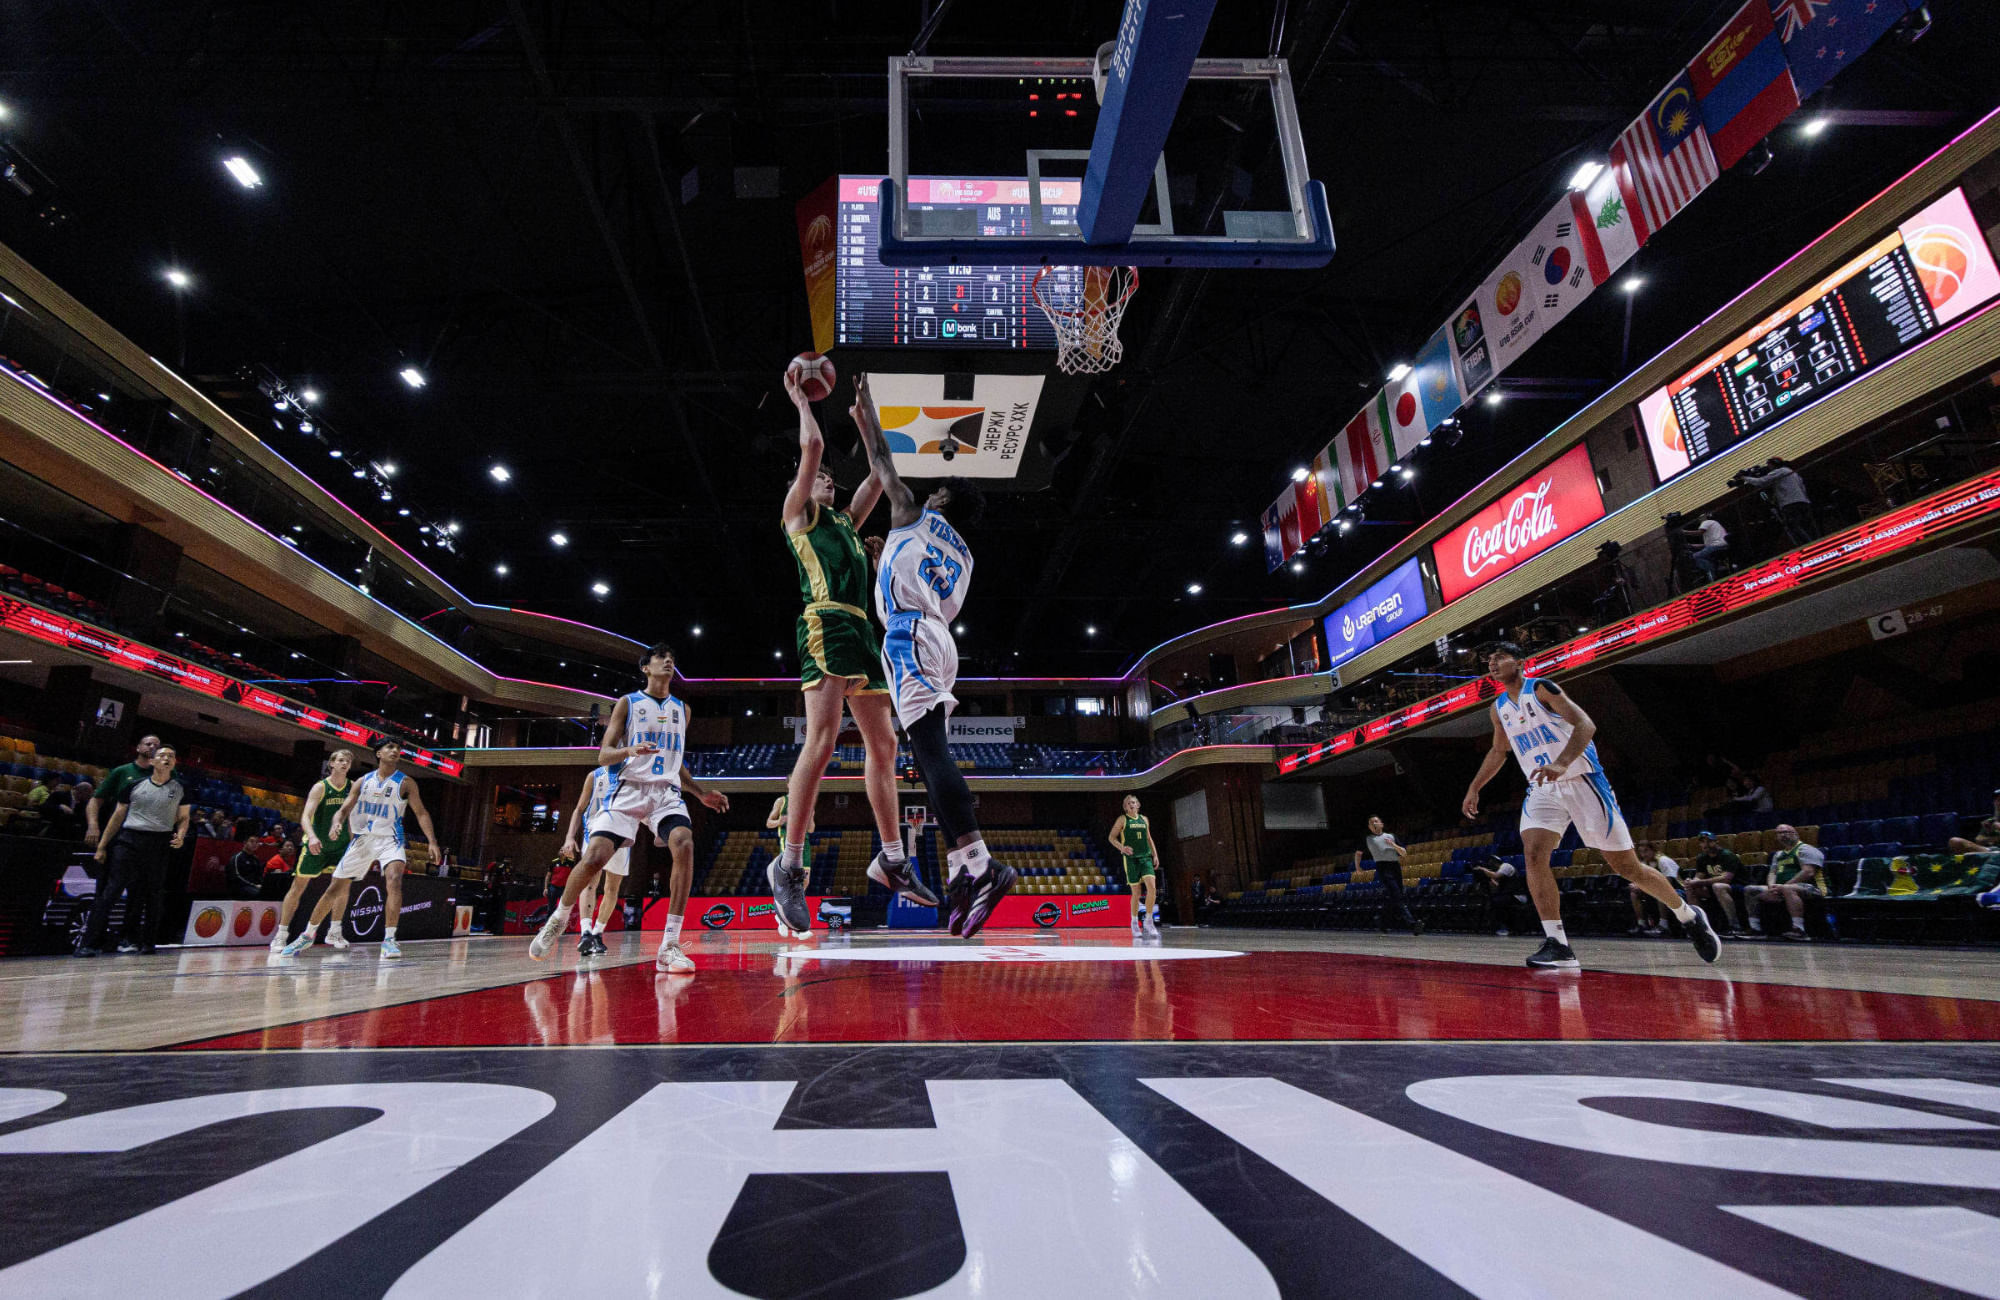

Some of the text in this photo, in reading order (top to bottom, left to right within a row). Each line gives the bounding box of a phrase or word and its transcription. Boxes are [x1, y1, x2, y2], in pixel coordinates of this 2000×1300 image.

[987, 207, 1001, 221] AUS
[923, 286, 929, 300] 2
[956, 285, 965, 299] 21
[992, 287, 998, 301] 2
[1524, 310, 1535, 325] CUP
[923, 321, 929, 336] 3
[993, 321, 997, 337] 1
[1812, 331, 1821, 343] 7
[1464, 347, 1485, 371] FIBA
[983, 411, 1006, 452] ЭНЕРЖИ
[1000, 402, 1030, 460] РЕСУРС ХХК
[1462, 476, 1558, 578] Coca-Cola
[918, 541, 962, 601] 23
[1386, 608, 1404, 623] GROUP
[1878, 615, 1897, 634] C
[104, 702, 116, 718] A
[950, 724, 1013, 736] Hisense
[651, 756, 665, 776] 6
[1534, 752, 1552, 768] 21
[358, 799, 389, 819] INDIA
[1137, 831, 1142, 840] 11
[350, 904, 383, 918] NISSAN
[748, 904, 776, 913] MON
[1072, 899, 1109, 911] MONNIS
[703, 910, 736, 921] NISSAN
